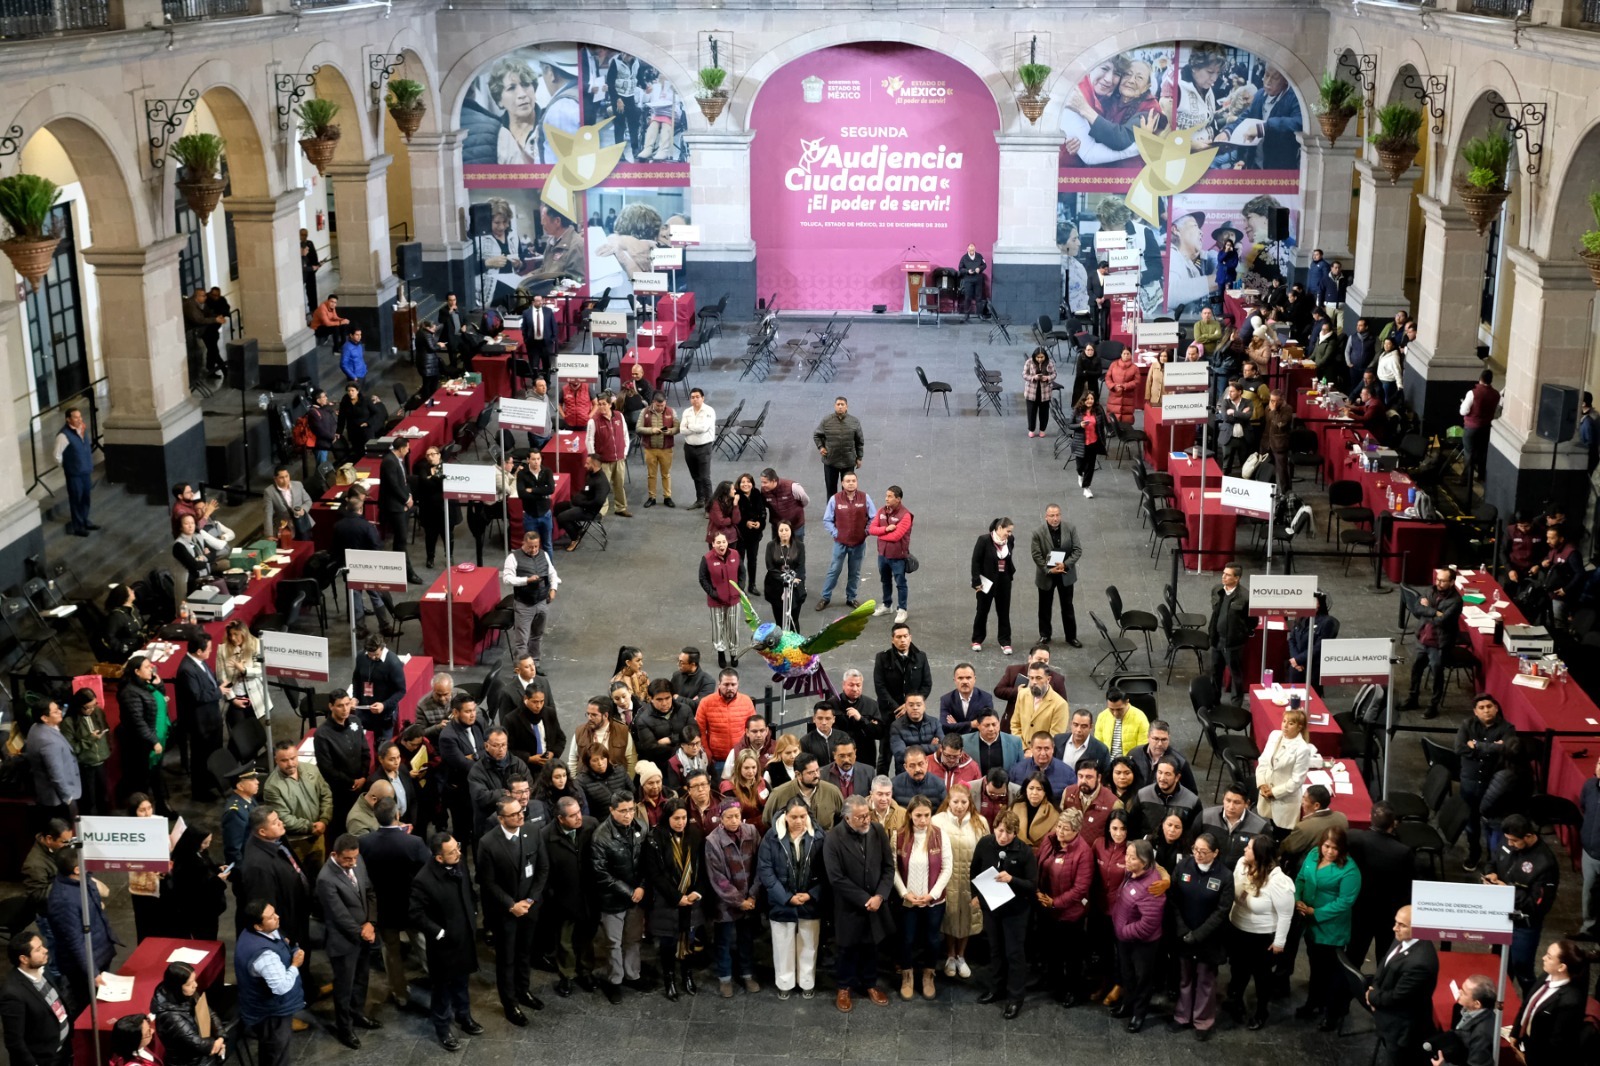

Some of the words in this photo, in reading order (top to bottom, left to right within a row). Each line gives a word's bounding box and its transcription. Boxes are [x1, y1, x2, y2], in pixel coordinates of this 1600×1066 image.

[828, 90, 861, 99] MÉXICO
[900, 86, 946, 97] MÉXICO
[840, 126, 908, 138] SEGUNDA
[821, 144, 963, 169] Audiencia
[784, 167, 938, 192] Ciudadana
[807, 194, 828, 214] ¡El
[831, 194, 877, 214] poder
[879, 194, 899, 211] de
[901, 194, 951, 212] servir!
[1164, 403, 1204, 411] CONTRALORÍA
[1225, 486, 1250, 497] AGUA
[1253, 588, 1303, 596] MOVILIDAD
[263, 645, 287, 654] MEDIO
[287, 648, 323, 658] AMBIENTE
[1323, 654, 1360, 662] OFICIALÍA
[83, 832, 146, 842] MUJERES
